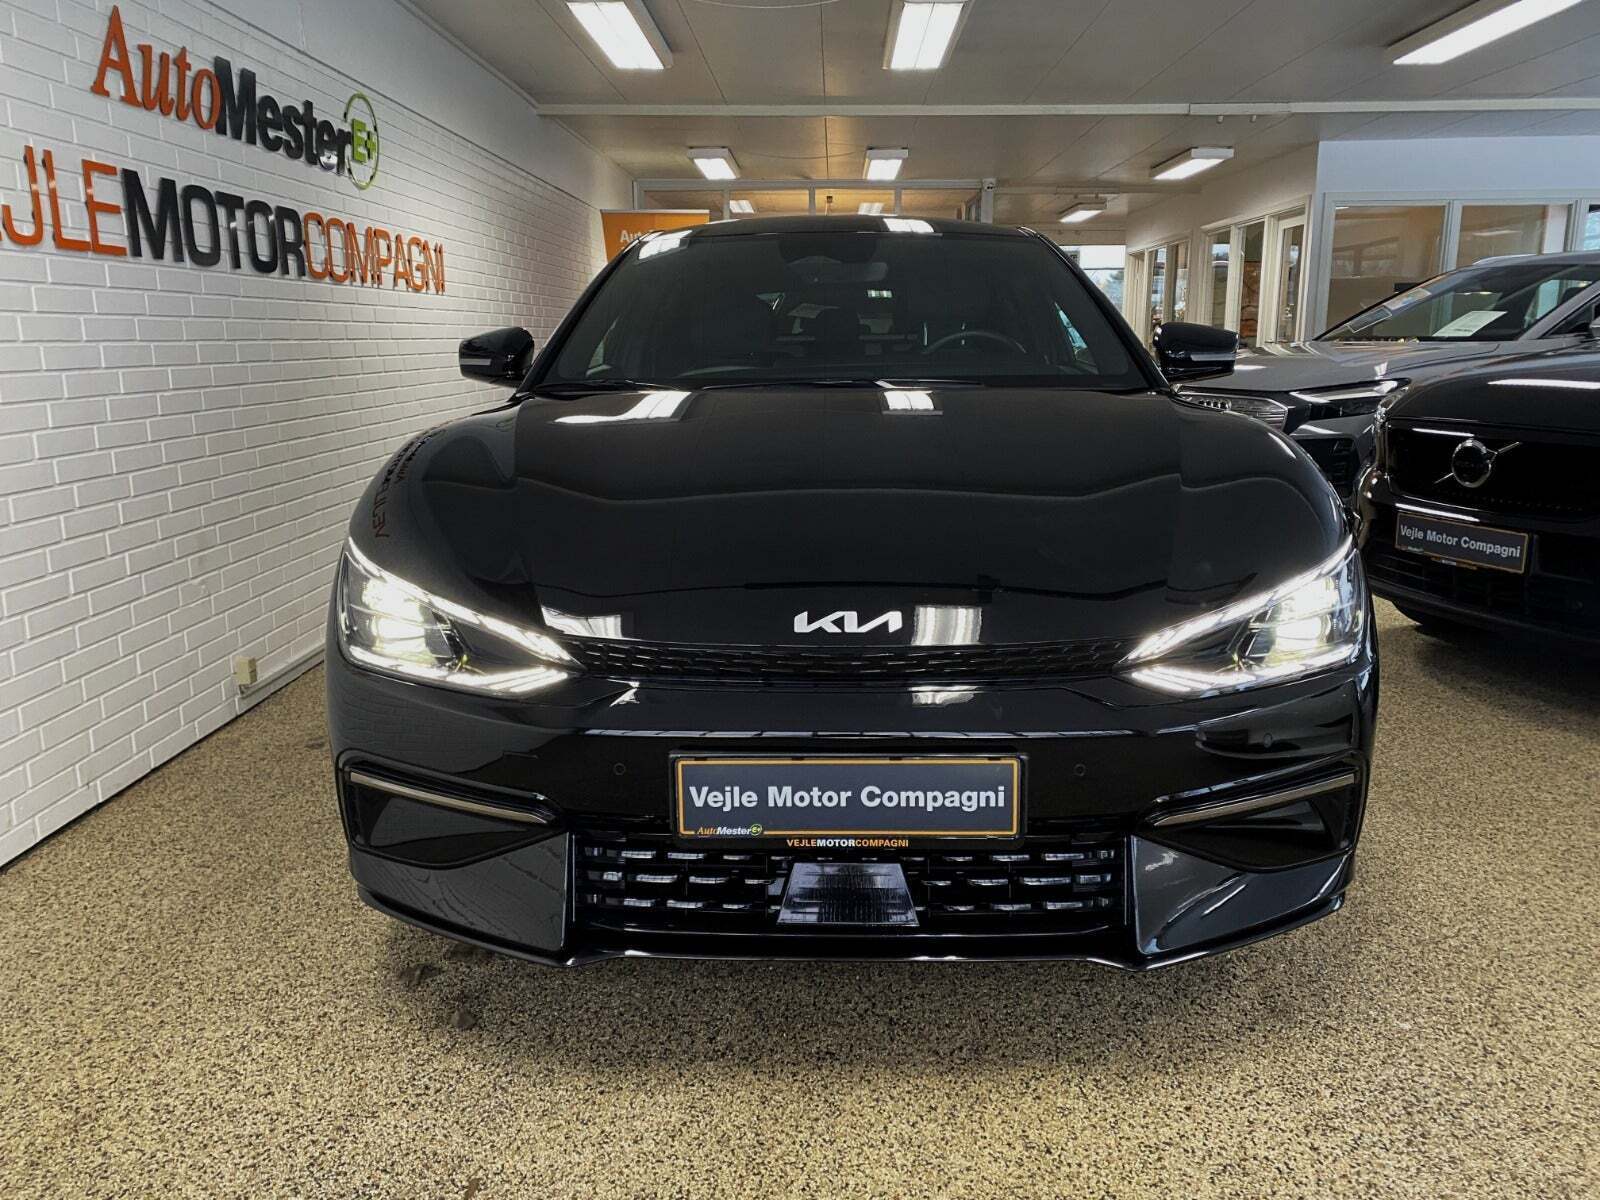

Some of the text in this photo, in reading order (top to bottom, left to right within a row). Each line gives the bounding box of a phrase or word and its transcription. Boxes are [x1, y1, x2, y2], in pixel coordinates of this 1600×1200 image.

[0, 144, 446, 294] JLEMOTORCOMPAGNI
[1400, 524, 1521, 558] Vejle Motor Compagni
[794, 611, 902, 633] KIA
[689, 786, 1005, 812] Vejle Motor Compagni
